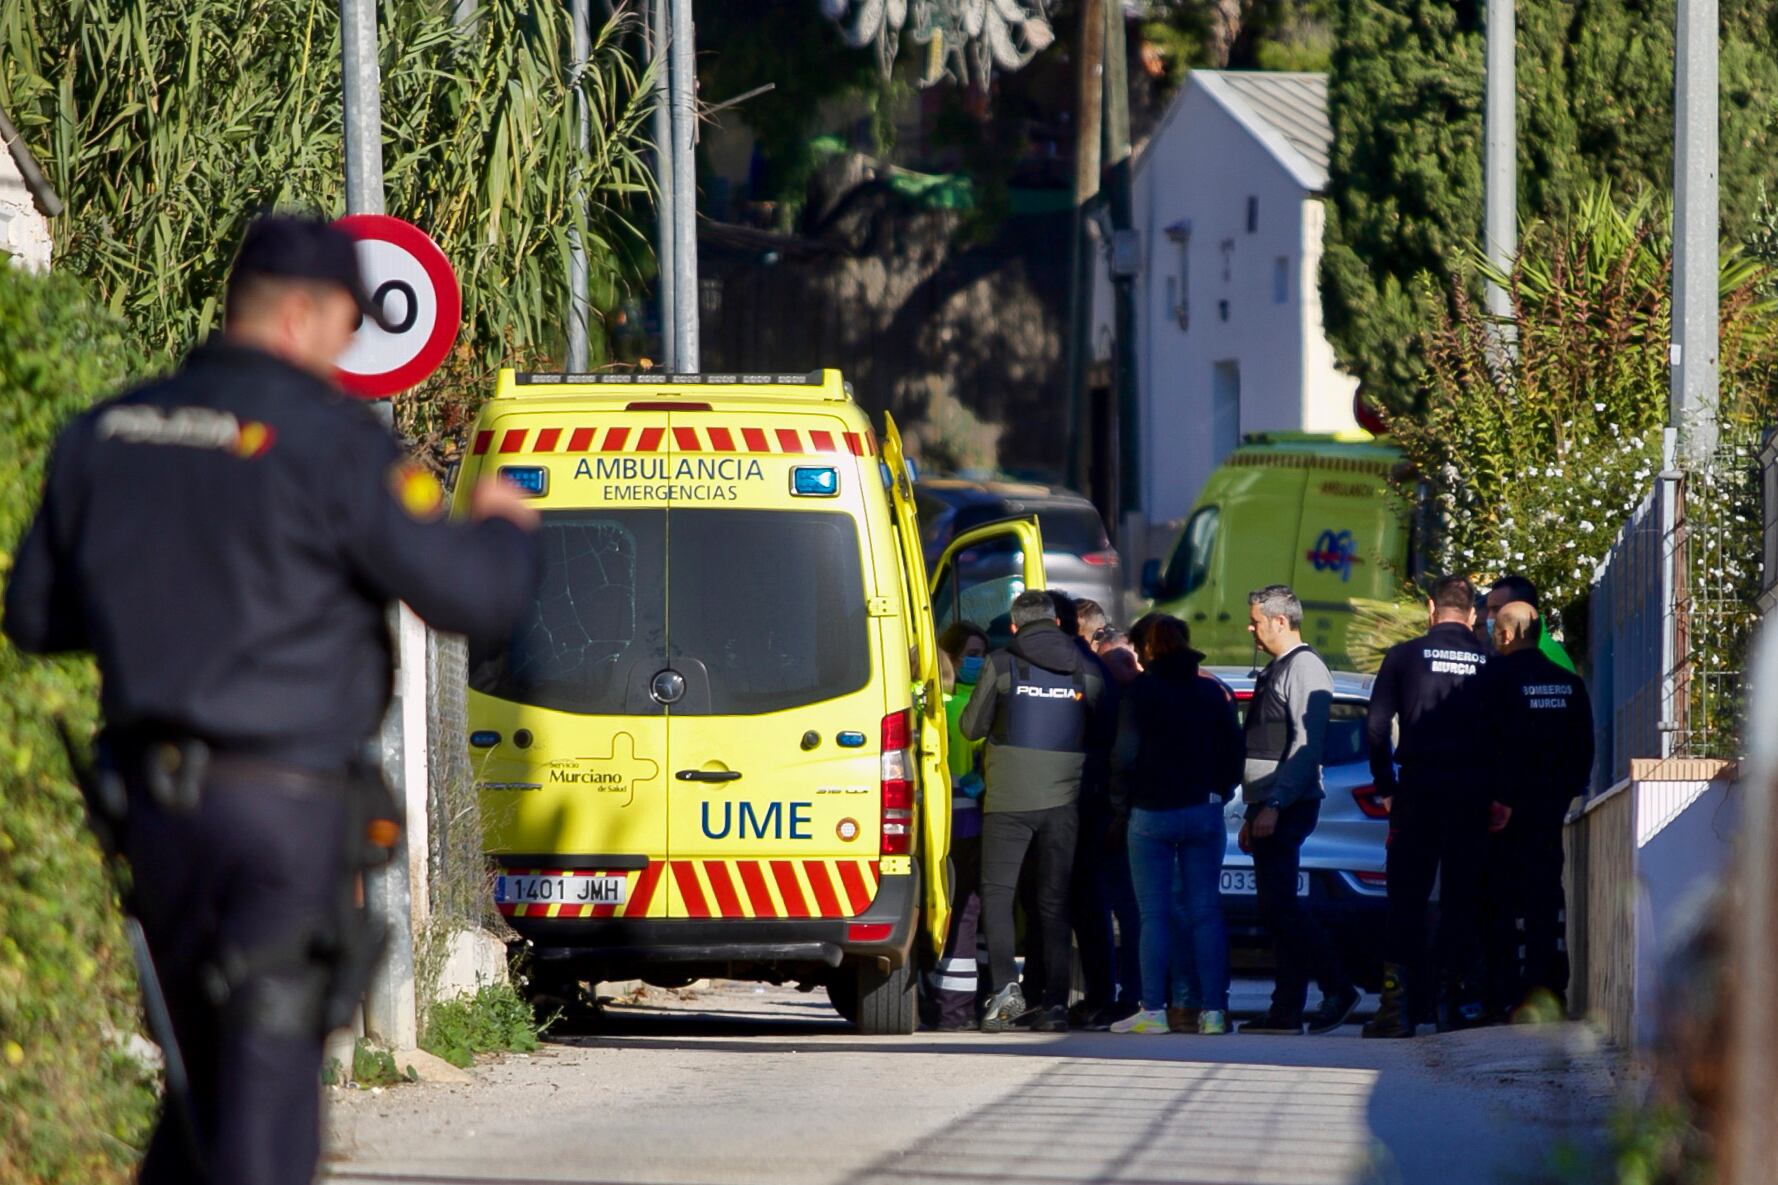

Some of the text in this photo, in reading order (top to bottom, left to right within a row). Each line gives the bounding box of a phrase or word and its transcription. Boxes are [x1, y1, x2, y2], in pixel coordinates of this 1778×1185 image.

[354, 280, 418, 334] 0
[574, 458, 764, 480] AMBULANCIA
[603, 485, 737, 500] EMERGENCIAS
[1423, 649, 1486, 664] BOMBEROS
[1431, 660, 1476, 675] MURCIA
[1016, 686, 1076, 699] POLICIA
[1523, 685, 1573, 695] BOMBEROS
[1530, 699, 1567, 708] MURCIA
[550, 769, 622, 783] Murciano
[597, 785, 627, 793] de Salud
[702, 801, 812, 839] UME
[1220, 871, 1257, 891] 033
[515, 879, 618, 900] 1401 JMH
